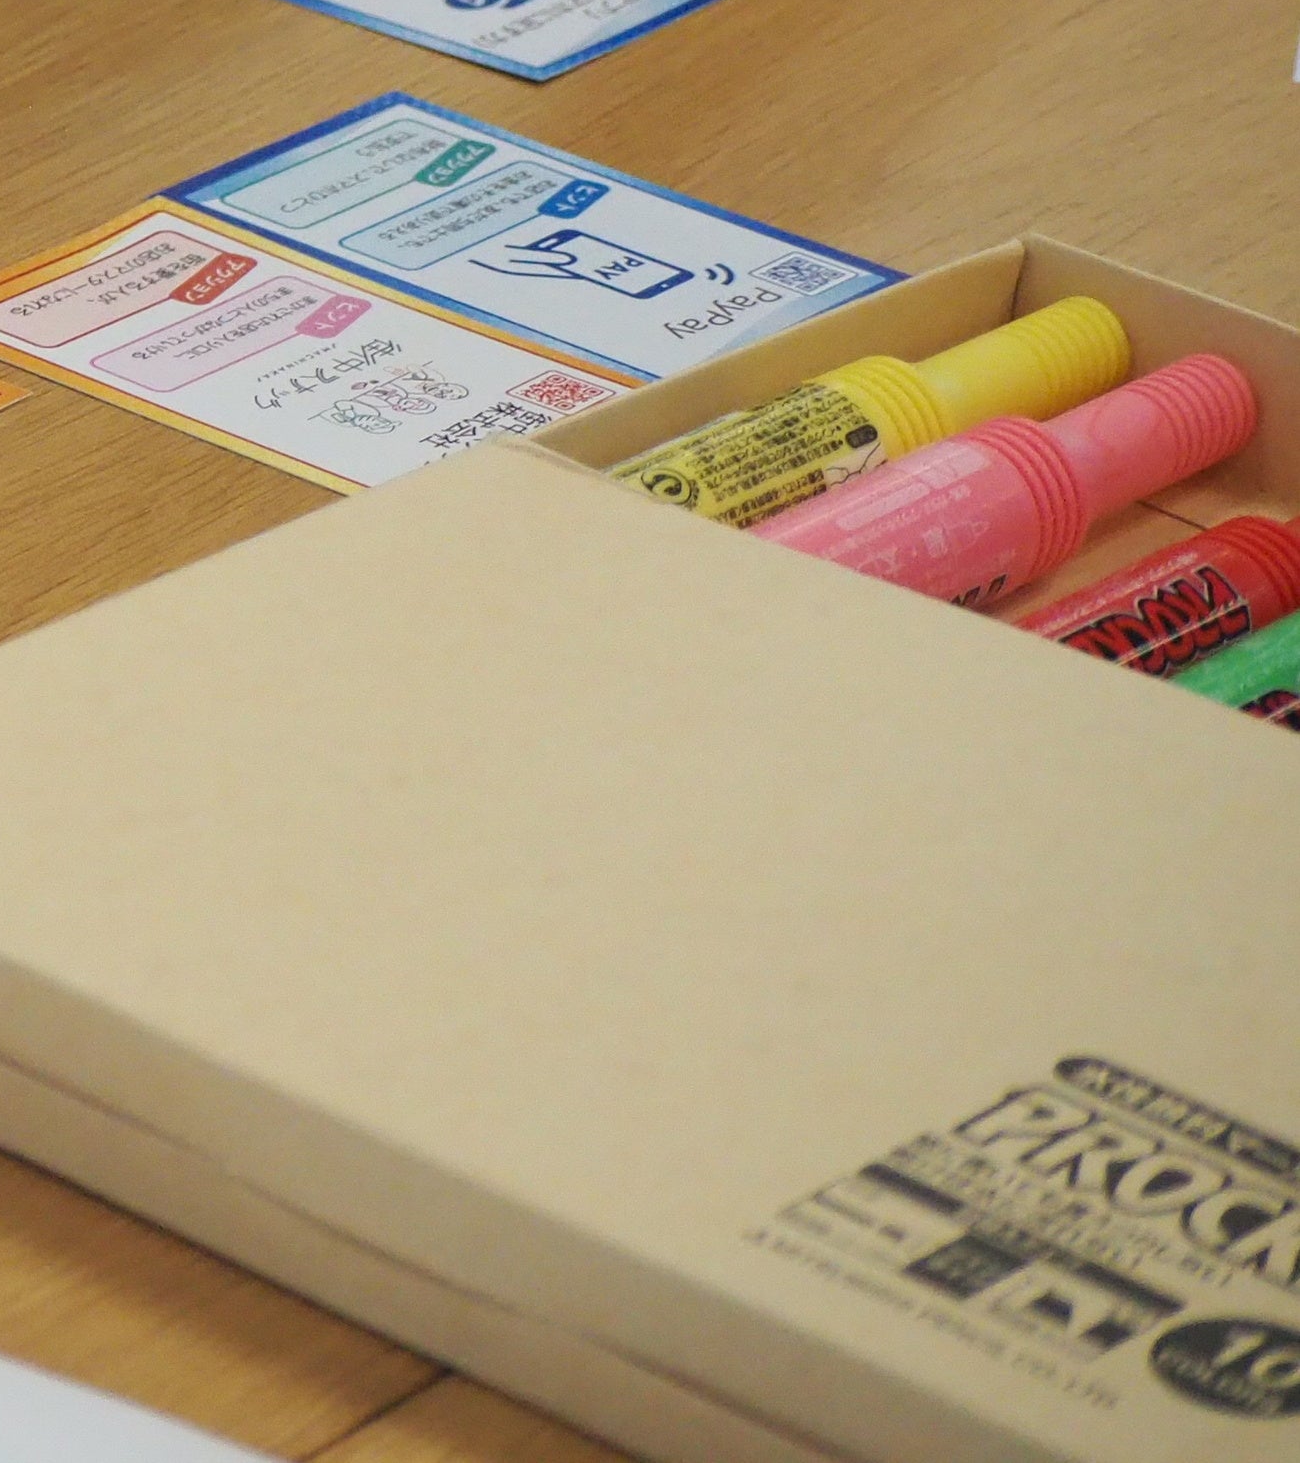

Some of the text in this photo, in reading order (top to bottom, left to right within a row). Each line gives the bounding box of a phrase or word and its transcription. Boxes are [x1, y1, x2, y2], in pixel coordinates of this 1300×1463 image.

[428, 145, 485, 183] アクション
[557, 185, 598, 211] ヒント
[10, 243, 176, 316] お店のマスターになれる
[88, 254, 206, 305] 街を愛する人が、
[185, 260, 246, 301] アクション
[594, 256, 644, 280] PAY
[131, 287, 293, 360] まちの人とつながっていける
[315, 302, 359, 330] ヒント
[663, 287, 783, 339] PayPay
[419, 402, 524, 448] 株式会社
